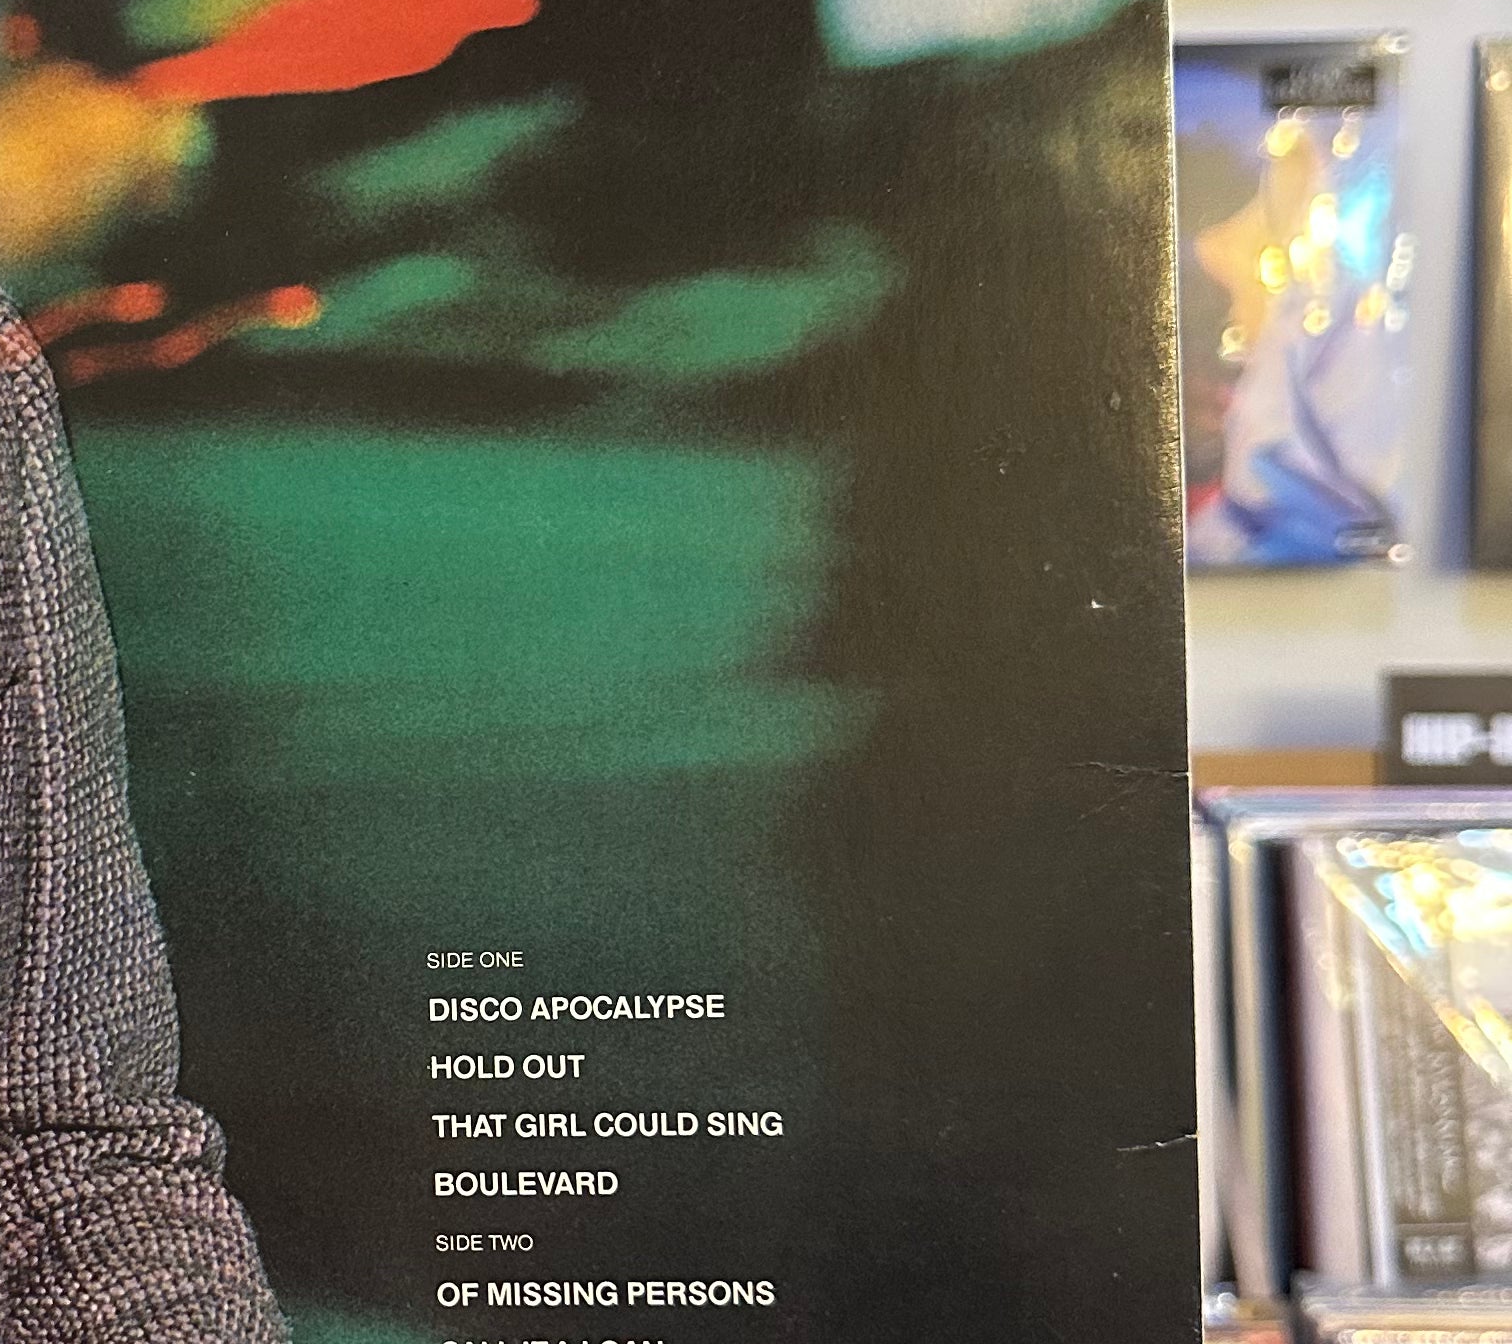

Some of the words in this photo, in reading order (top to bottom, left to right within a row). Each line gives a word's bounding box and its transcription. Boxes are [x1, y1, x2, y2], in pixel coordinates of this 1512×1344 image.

[426, 952, 474, 969] SIDE
[479, 951, 525, 968] ONE
[428, 996, 523, 1022] DISCO
[530, 994, 726, 1020] APOCALYPSE
[430, 1055, 515, 1080] HOLD
[522, 1054, 586, 1079] OUT
[432, 1113, 507, 1138] THAT
[514, 1113, 587, 1138] GIRL
[593, 1112, 699, 1137] COULD
[706, 1111, 784, 1136] SING
[434, 1171, 619, 1196] BOULEVARD
[435, 1234, 484, 1252] SIDE
[488, 1234, 534, 1251] TWO
[436, 1282, 480, 1307] OF
[488, 1281, 619, 1307] MISSING
[627, 1280, 776, 1306] PERSONS
